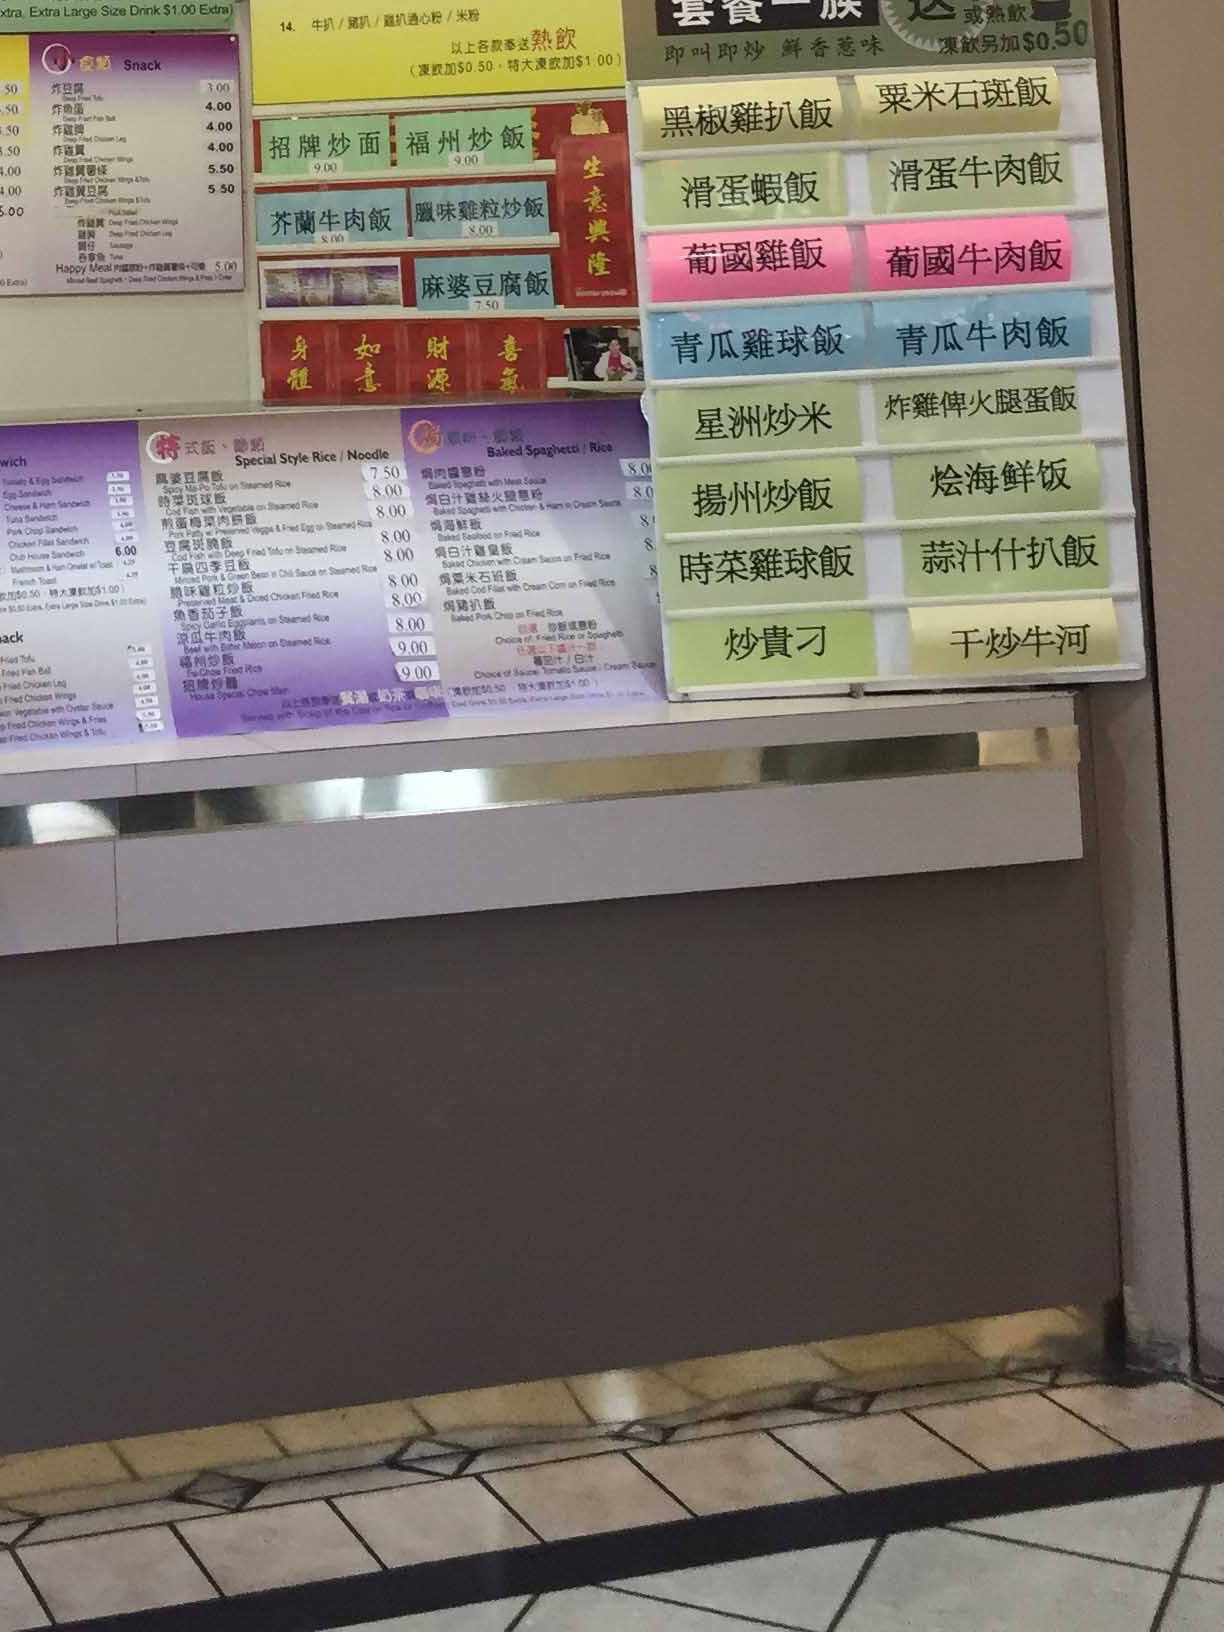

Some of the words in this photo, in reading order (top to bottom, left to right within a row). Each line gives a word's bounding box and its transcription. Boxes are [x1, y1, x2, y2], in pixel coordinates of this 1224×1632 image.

[63, 4, 97, 22] Large
[100, 3, 126, 18] Size
[129, 3, 161, 17] Drink
[163, 3, 196, 17] $1.00
[280, 21, 295, 32] 14.
[123, 58, 161, 72] Snack
[664, 41, 766, 63] 即叫即炒
[876, 76, 1051, 114] 粟米石斑飯
[206, 121, 232, 132] 4.00
[661, 98, 832, 138] 黑椒雞扒飯
[268, 131, 380, 160] 招牌炒面
[406, 124, 524, 157] 福州炒飯
[208, 163, 234, 174] 5.50
[314, 161, 337, 173] 9.00
[455, 154, 478, 166] 9.00
[889, 152, 1064, 192] 滑蛋牛肉飯
[681, 172, 819, 209] 滑蛋蝦飯
[271, 207, 392, 237] 芥蘭牛肉飯
[469, 224, 493, 236] 8.00
[583, 156, 611, 278] 生意興隆
[56, 263, 86, 275] Happy
[684, 238, 826, 276] 葡國雞飯
[886, 240, 1064, 278] 葡國牛肉飯
[422, 270, 549, 299] 麻婆豆腐飯
[671, 324, 845, 364] 青瓜雞球飯
[896, 317, 1069, 356] 青瓜牛肉飯
[354, 334, 382, 393] 如意
[426, 336, 451, 393] 財源
[695, 402, 832, 441] 星洲炒米
[235, 454, 276, 468] Special
[280, 452, 309, 465] Style
[312, 450, 336, 462] Rice
[347, 449, 389, 461] Noodle
[487, 445, 522, 458] Baked
[526, 444, 580, 458] Spaghetti
[590, 442, 612, 453] Rice
[241, 481, 273, 490] Steamed
[276, 479, 291, 488] Rice
[931, 459, 1072, 498] 烩海鲜饭
[693, 478, 833, 518] 揚州炒飯
[115, 545, 137, 556] 6.00
[680, 545, 854, 586] 時菜雞球飯
[920, 534, 1099, 574] 蒜汁什扒飯
[395, 617, 425, 631] 8.00
[398, 640, 428, 655] 9.00
[724, 625, 827, 662] 炒貴刁
[951, 623, 1091, 659] 干炒牛河
[401, 665, 431, 679] 9.00
